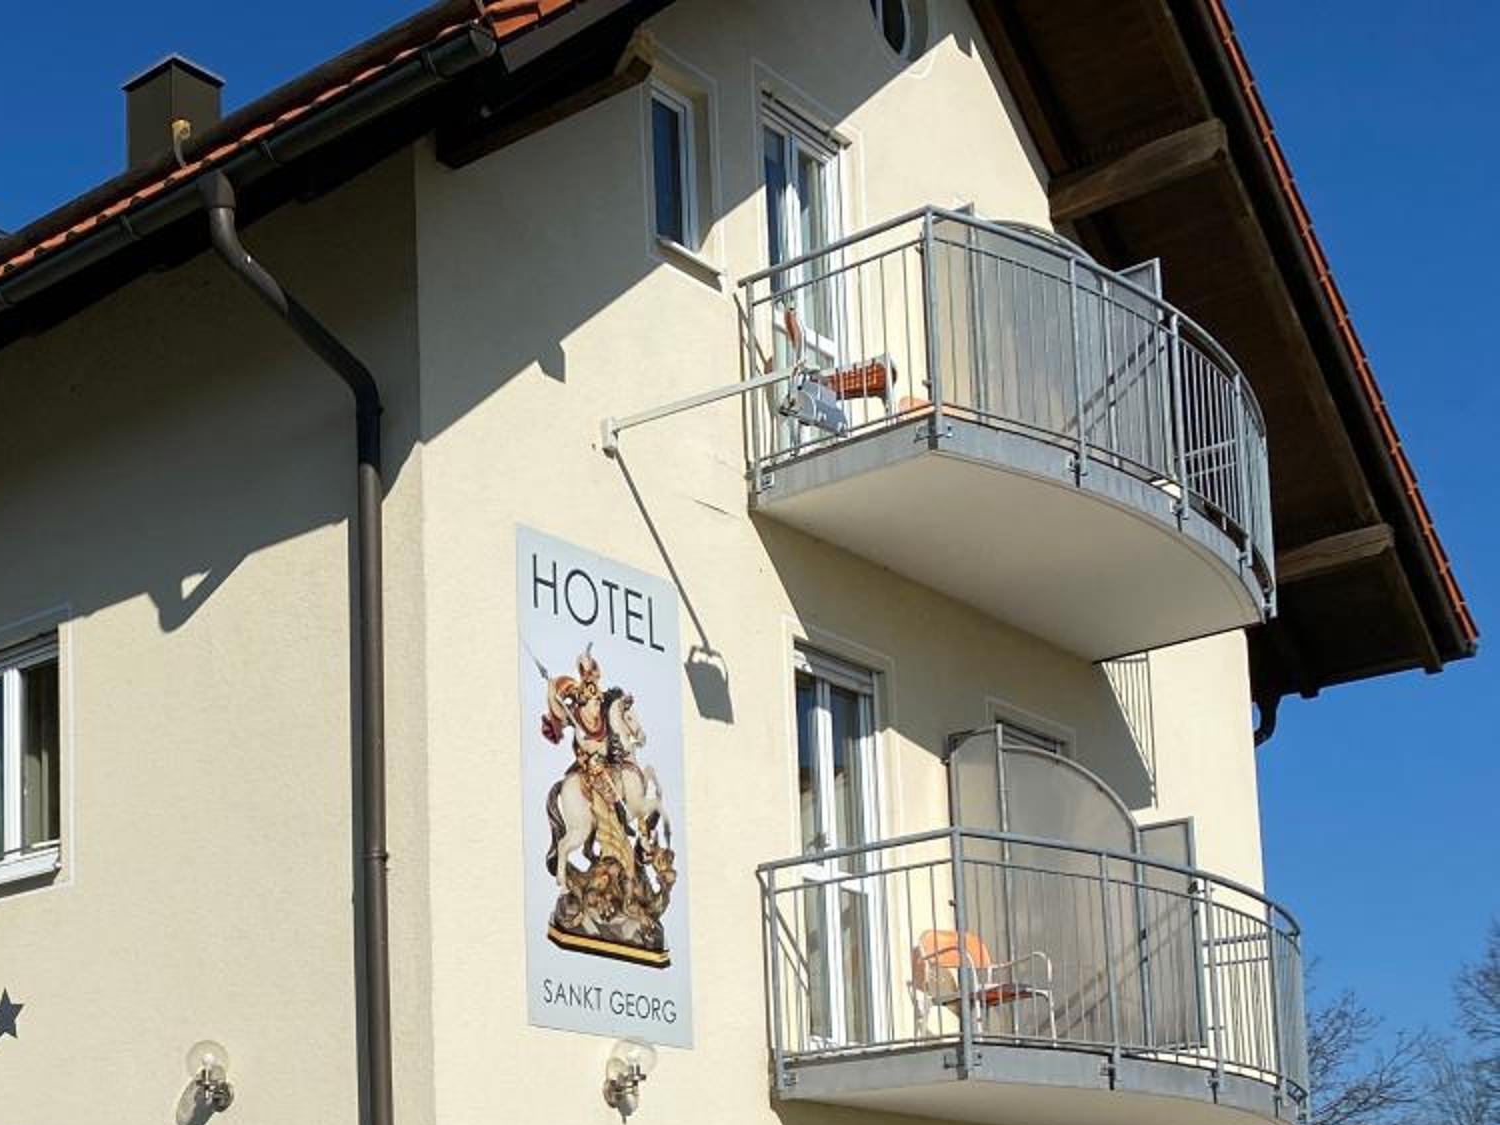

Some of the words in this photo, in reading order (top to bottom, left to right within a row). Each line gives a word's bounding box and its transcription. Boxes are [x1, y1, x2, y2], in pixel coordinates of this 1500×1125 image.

[532, 554, 665, 653] HOTEL
[543, 979, 603, 1012] SANKT
[610, 989, 677, 1024] GEORG
